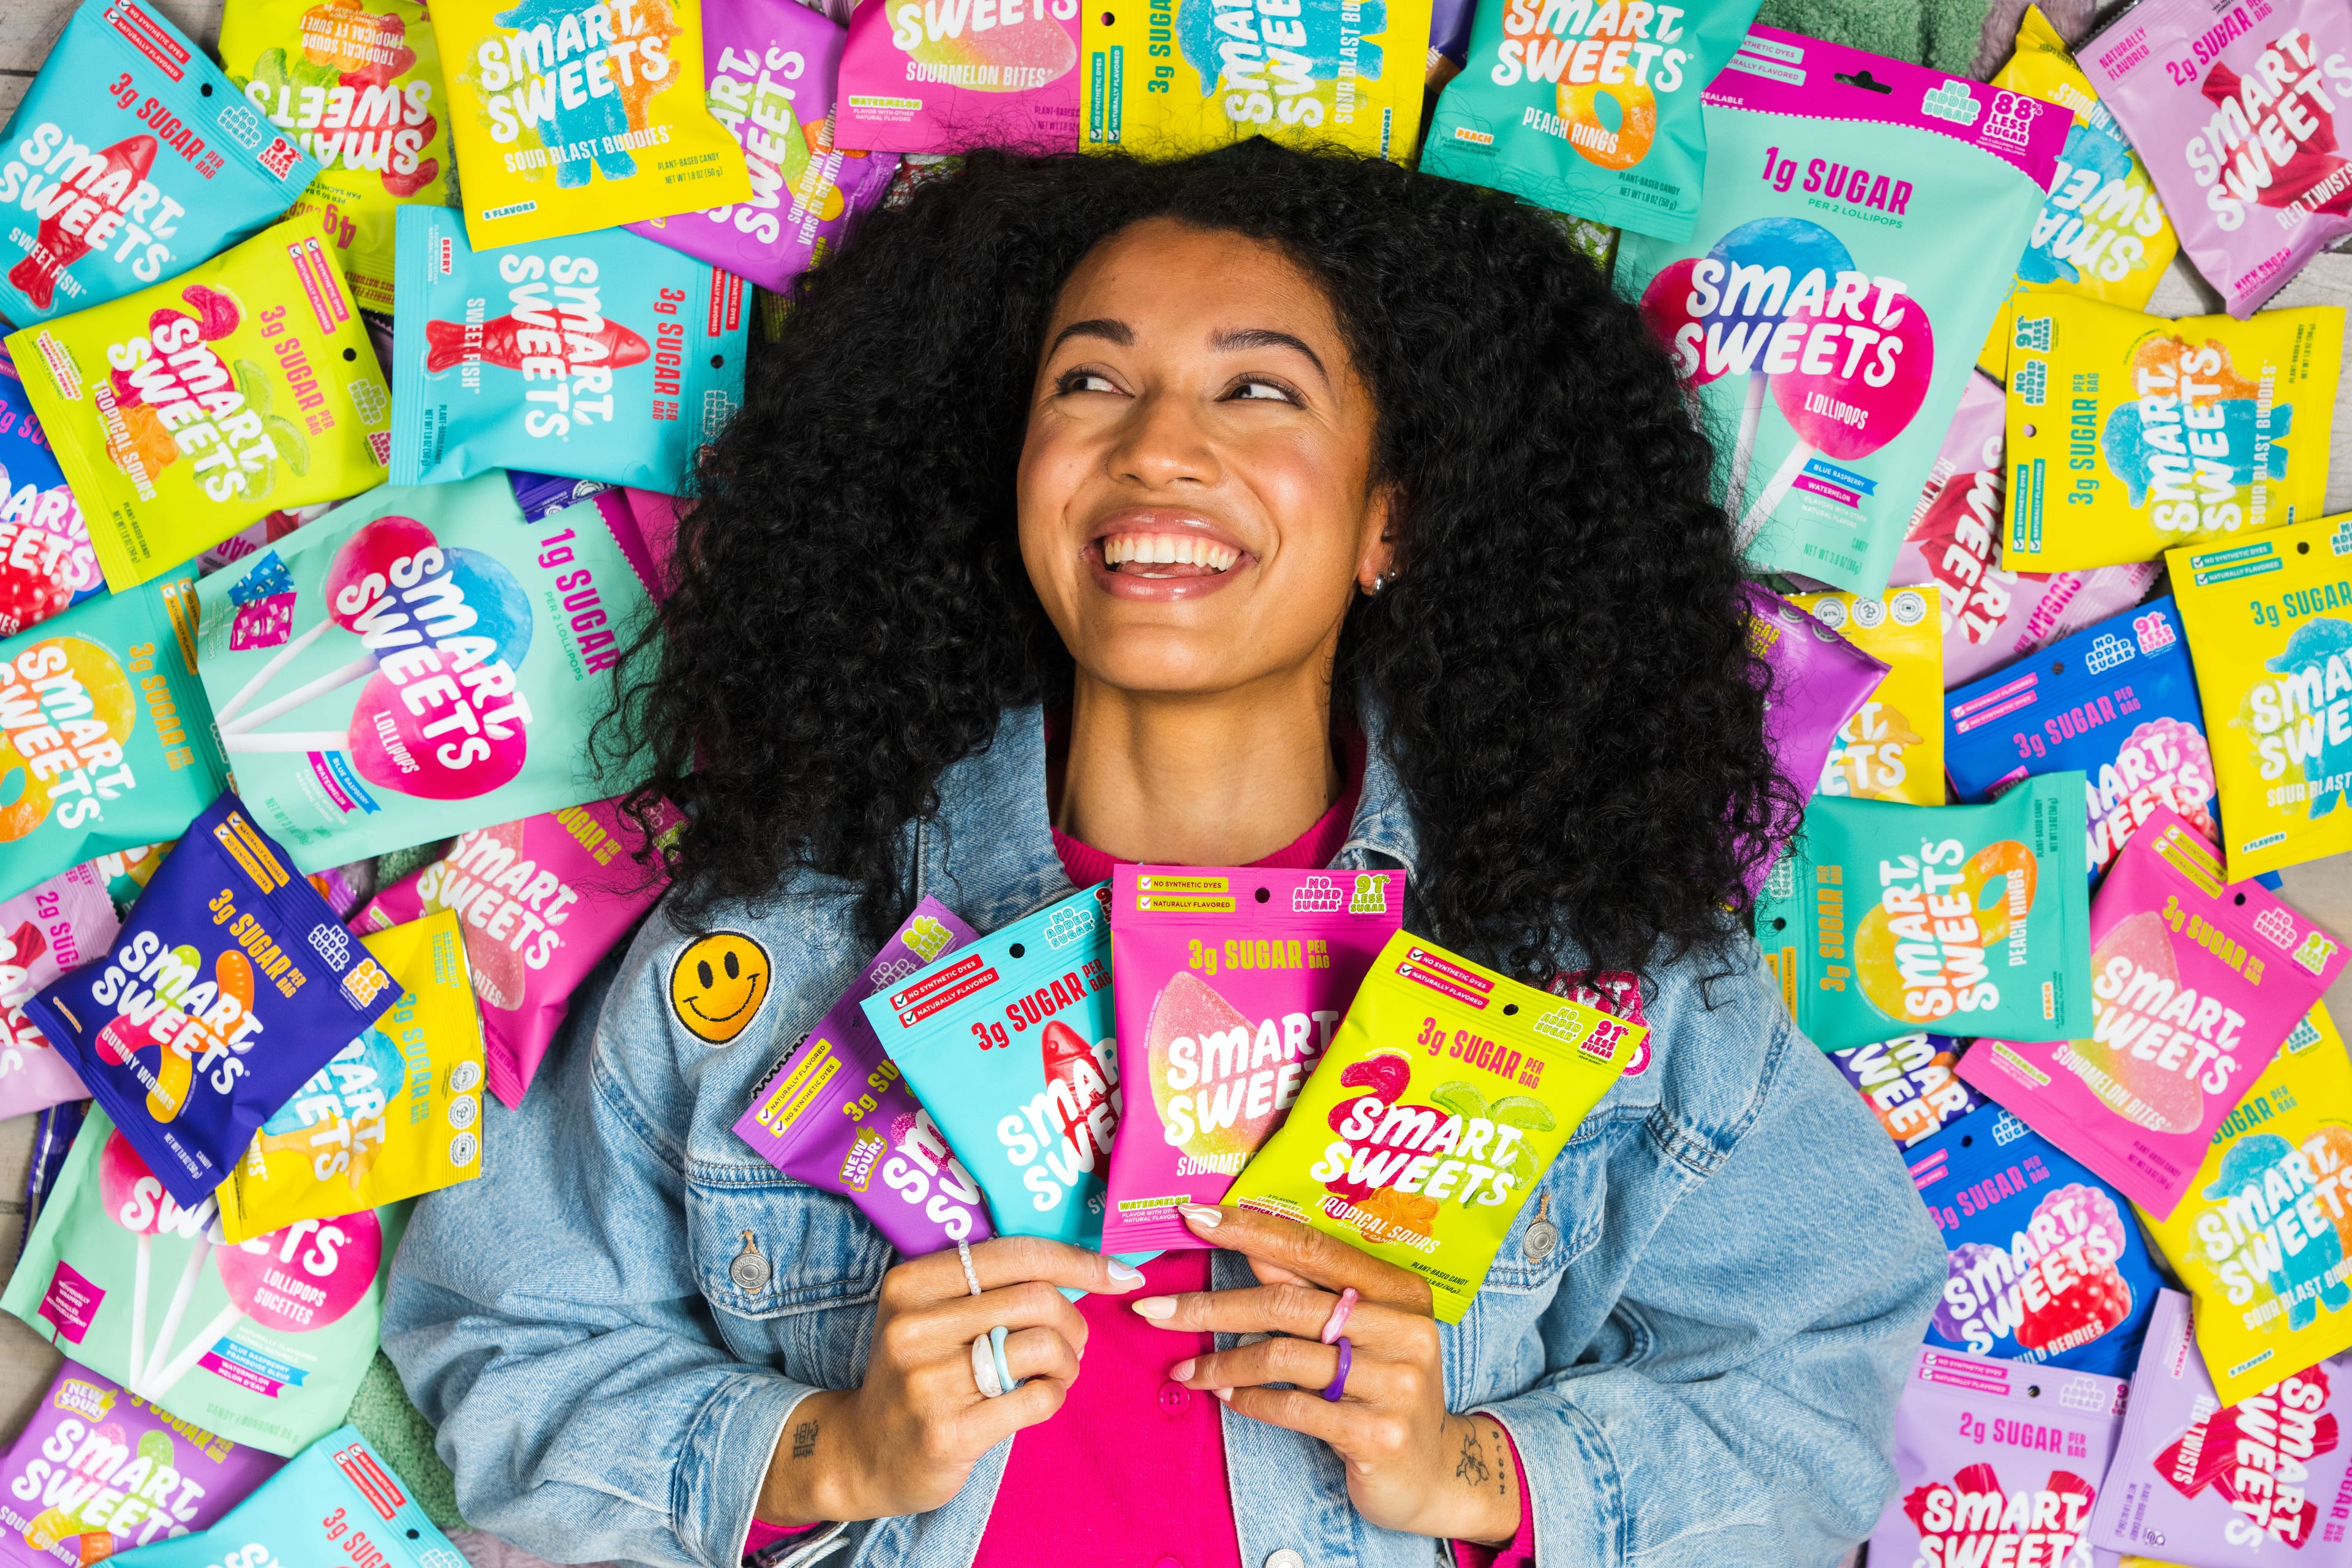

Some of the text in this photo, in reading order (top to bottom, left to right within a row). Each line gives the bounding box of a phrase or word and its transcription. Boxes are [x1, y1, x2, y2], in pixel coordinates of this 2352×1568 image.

[300, 15, 404, 50] TROPICAL ET SURET
[301, 34, 394, 66] TROPICAL SOURS
[2099, 27, 2150, 81] NATURALLY FLAVORED
[2166, 6, 2253, 87] 2g SUGAR
[490, 36, 670, 143] SWEETS
[907, 61, 998, 86] SOURMELON
[1334, 29, 1359, 124] SOUR BLAST
[1491, 40, 1687, 92] SWEETS
[1758, 66, 1799, 81] FLAVORED
[109, 72, 205, 164] 3g SUGAR
[850, 96, 922, 111] WATERMELON
[1992, 115, 2027, 132] LESS
[2185, 28, 2311, 186] SMART
[1455, 128, 1493, 144] PEACH
[1522, 107, 1619, 154] PEACH RINGS
[1985, 124, 2027, 144] SUGAR
[20, 123, 185, 239] SMART
[503, 147, 546, 173] SOUR
[551, 139, 598, 165] BLAST
[1762, 146, 1913, 216] 1g SUGAR
[787, 145, 827, 224] SOUR GUMMY
[0, 161, 170, 282] SWEETS
[1807, 198, 1903, 229] PER 2 LOLLIPOPS
[442, 239, 450, 274] BERRY
[1686, 258, 1907, 325] SMART
[464, 298, 485, 349] SWEET
[499, 254, 570, 439] SWEETS
[550, 255, 614, 423] SMART
[652, 288, 686, 395] 3g SUGAR
[260, 304, 325, 413] 3g SUGAR
[1675, 322, 1904, 387] SWEETS
[152, 317, 277, 464] SMART
[1804, 391, 1868, 429] LOLLIPOPS
[92, 377, 156, 502] TROPICAL SOURS
[107, 337, 246, 502] SWEETS
[2180, 347, 2242, 532] SWEETS
[2068, 396, 2099, 505] 3g SUGAR
[2138, 368, 2200, 532] SMART
[2253, 433, 2270, 478] BLAST
[1807, 481, 1851, 502] WATERMELON
[1814, 464, 1864, 488] BLUE RASPBERRY
[2250, 480, 2266, 525] SOUR
[538, 527, 622, 676] 1g SUGAR
[2250, 600, 2280, 627] 3g
[390, 546, 533, 729] SMART
[129, 643, 186, 747] 3g SUGAR
[336, 572, 491, 769] SWEETS
[17, 646, 135, 791] SMART
[374, 710, 420, 774] LOLLIPOPS
[2013, 694, 2119, 759] 3g SUGAR
[315, 762, 347, 807] WATERMELON
[2267, 786, 2305, 807] SOUR
[2249, 834, 2285, 850] FLAVORS
[36, 891, 60, 920] 2g
[1153, 900, 1231, 909] NATURALLY FLAVORED
[1294, 888, 1342, 901] ADDED
[1308, 876, 1330, 889] NO
[1354, 893, 1384, 903] LESS
[1356, 874, 1390, 894] 91%
[417, 861, 560, 970] SWEETS
[1052, 908, 1074, 925] NO
[1351, 903, 1386, 913] SUGAR
[1921, 839, 2000, 1012] SWEETS
[2007, 869, 2027, 967] PEACH RINGS
[209, 889, 291, 986] 3g SUGAR
[432, 934, 446, 984] FLAVORED
[1188, 939, 1303, 976] 3g SUGAR
[1308, 940, 1327, 954] PER
[1817, 887, 1849, 992] 3g SUGAR
[1879, 861, 1953, 1017] SMART
[2163, 895, 2247, 973] 3g SUGAR
[442, 931, 461, 989] NATURALLY
[907, 960, 976, 1000] NO SYNTHETIC DYES
[1082, 959, 1104, 979] PER
[1308, 954, 1330, 969] BAG
[119, 931, 263, 1045] SMART
[916, 973, 994, 1017] NATURALLY FLAVORED
[971, 971, 1088, 1051] 3g SUGAR
[1411, 971, 1483, 1006] NATURALLY FLAVORED
[2043, 983, 2052, 1019] PEACH
[2094, 956, 2245, 1046] SMART
[92, 965, 244, 1095] SWEETS
[394, 993, 432, 1096] 3g SUGAR
[1166, 1011, 1338, 1090] SMART
[1417, 1017, 1522, 1080] 3g SUGAR
[1581, 1041, 1613, 1059] SUGAR
[1587, 1035, 1615, 1050] LESS
[1595, 1020, 1629, 1041] 91%
[101, 1026, 176, 1112] GUMMY WORMS
[1518, 1071, 1540, 1090] BAG
[1525, 1057, 1545, 1075] PER
[843, 1094, 877, 1122] 3g
[1340, 1096, 1523, 1163] SMART
[1310, 1141, 1515, 1206] SWEETS
[1957, 1166, 2027, 1216] SUGAR
[1120, 1196, 1190, 1210] WATERMELON
[1315, 1194, 1441, 1254] TROPICAL SOURS
[2197, 1136, 2327, 1262] SMART
[1338, 1222, 1399, 1247] GUMMY CANDY
[1943, 1199, 2078, 1320] SMART
[263, 1267, 326, 1308] LOLLIPOPS
[1411, 1261, 1469, 1286] PLANT-BASED CANDY
[1961, 1225, 2117, 1355] SWEETS
[254, 1289, 314, 1325] SUCETTES
[2242, 1276, 2323, 1330] SOUR BLAST
[229, 1343, 290, 1373] BLUE RASPBERRY
[2048, 1320, 2105, 1357] BERRIES
[68, 1382, 103, 1403] NEW
[1959, 1411, 2062, 1454] 2g SUGAR
[42, 1419, 205, 1518] SMART
[2272, 1378, 2323, 1540] SMART
[322, 1507, 347, 1541] 3g
[1922, 1490, 2087, 1532] SMART
